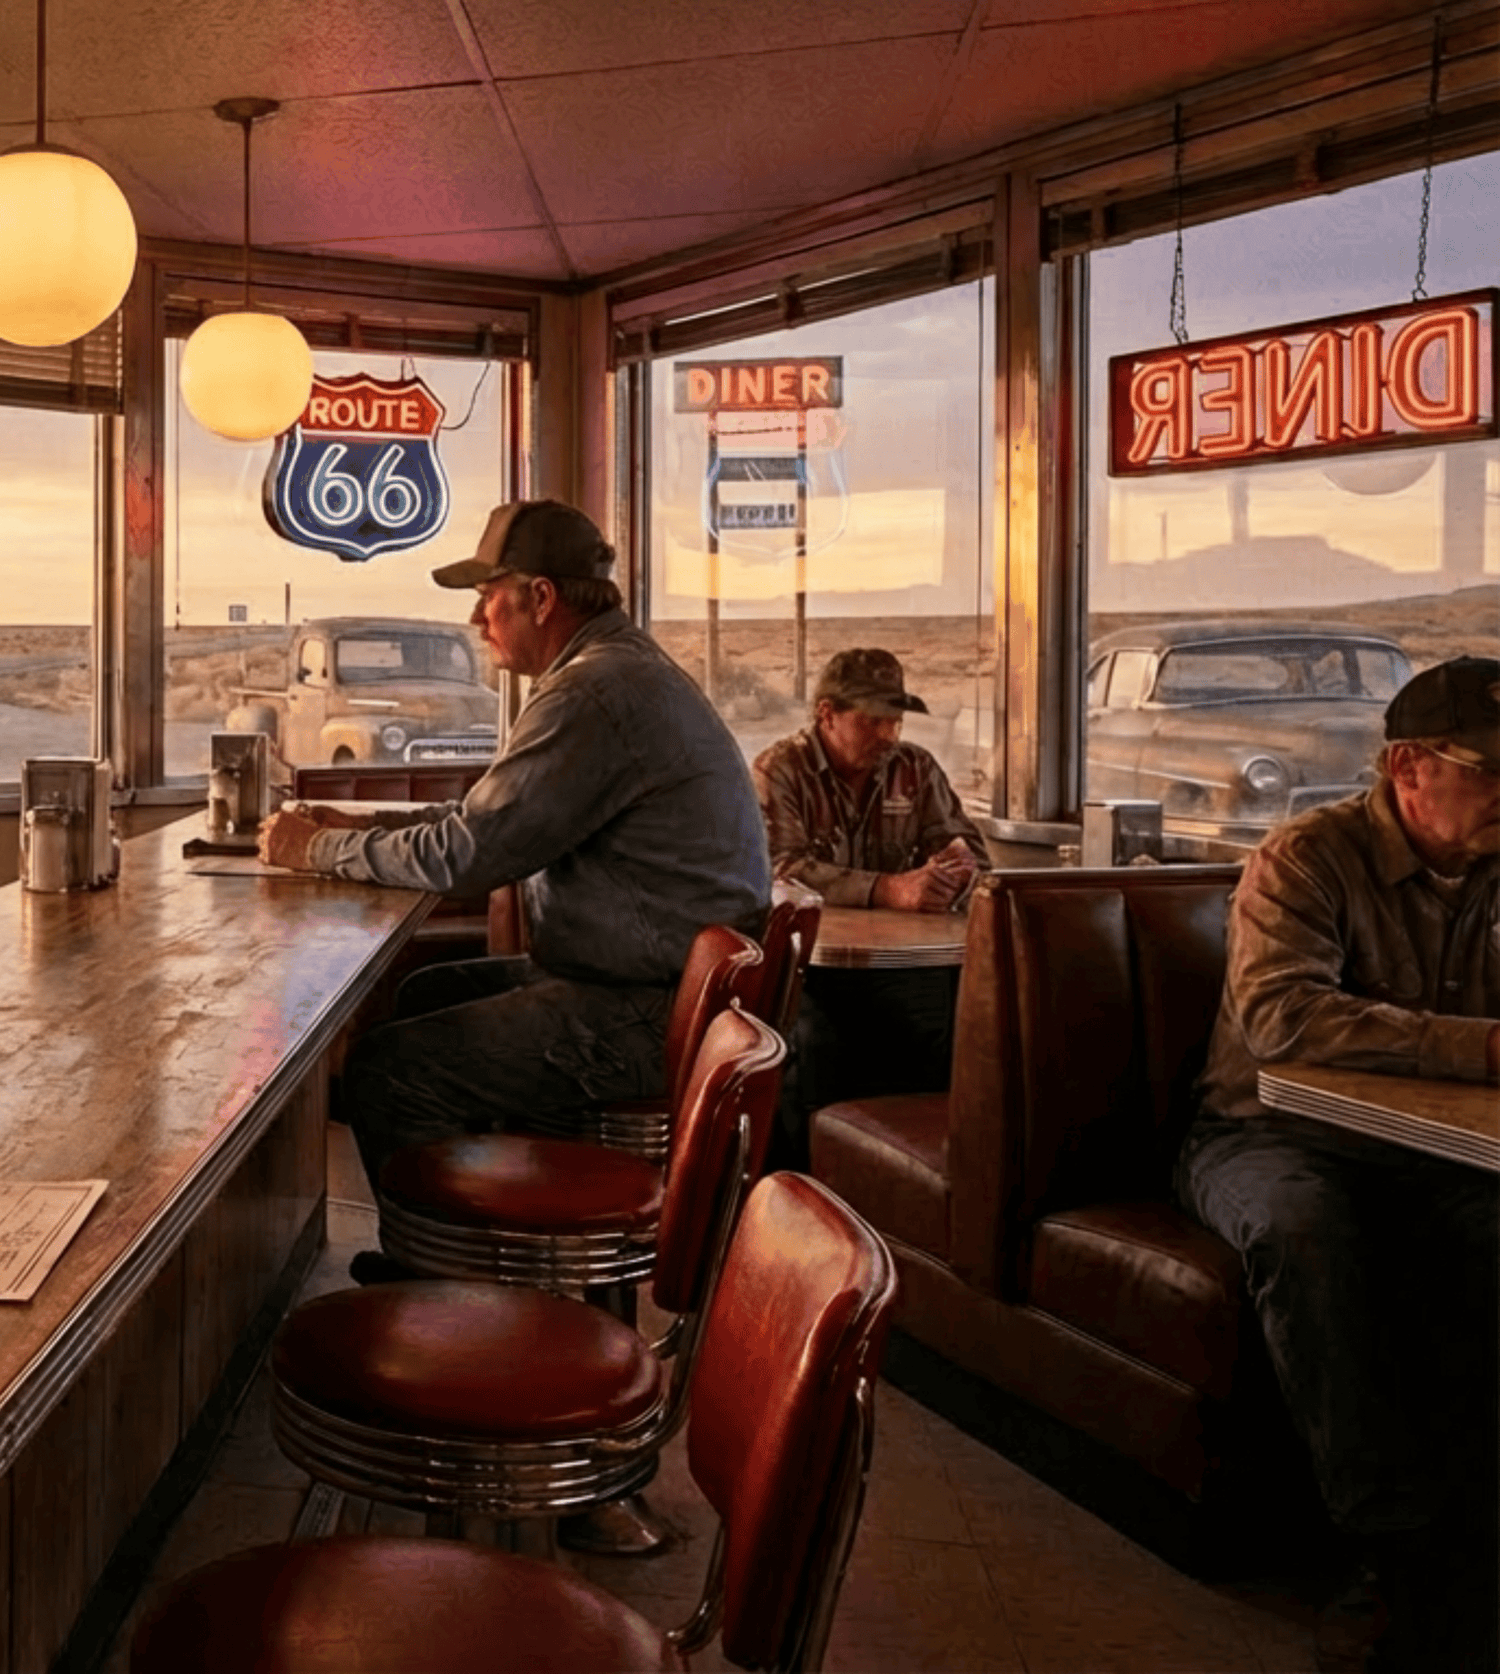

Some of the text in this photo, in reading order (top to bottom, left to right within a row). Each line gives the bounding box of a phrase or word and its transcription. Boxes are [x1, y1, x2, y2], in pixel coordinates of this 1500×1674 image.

[687, 364, 830, 405] DINER
[308, 396, 420, 430] ROUTE
[307, 442, 422, 529] 66
